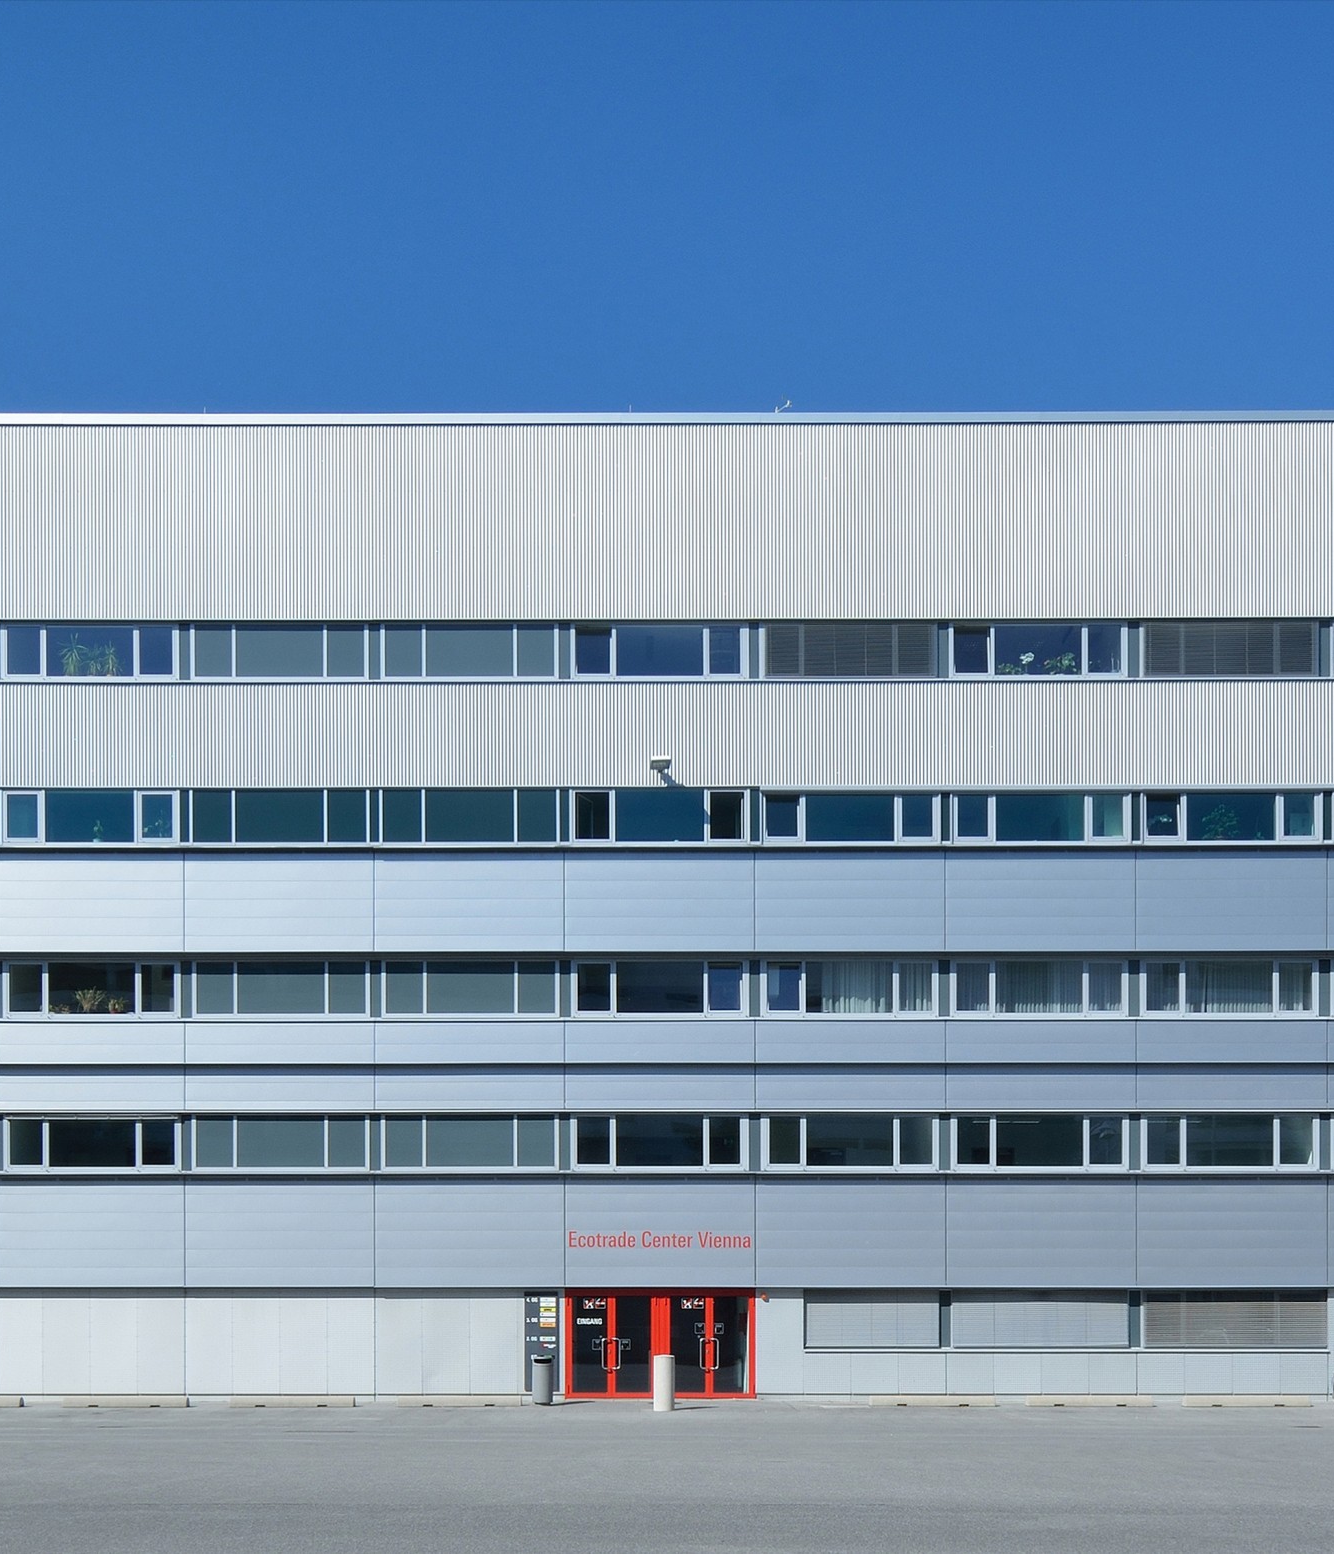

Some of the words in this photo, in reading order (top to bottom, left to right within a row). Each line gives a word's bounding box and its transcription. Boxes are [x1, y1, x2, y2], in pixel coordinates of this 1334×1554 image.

[568, 1231, 636, 1248] Ecotrade
[641, 1231, 693, 1248] Center
[698, 1231, 752, 1248] Vienna
[576, 1317, 603, 1325] EINGANG
